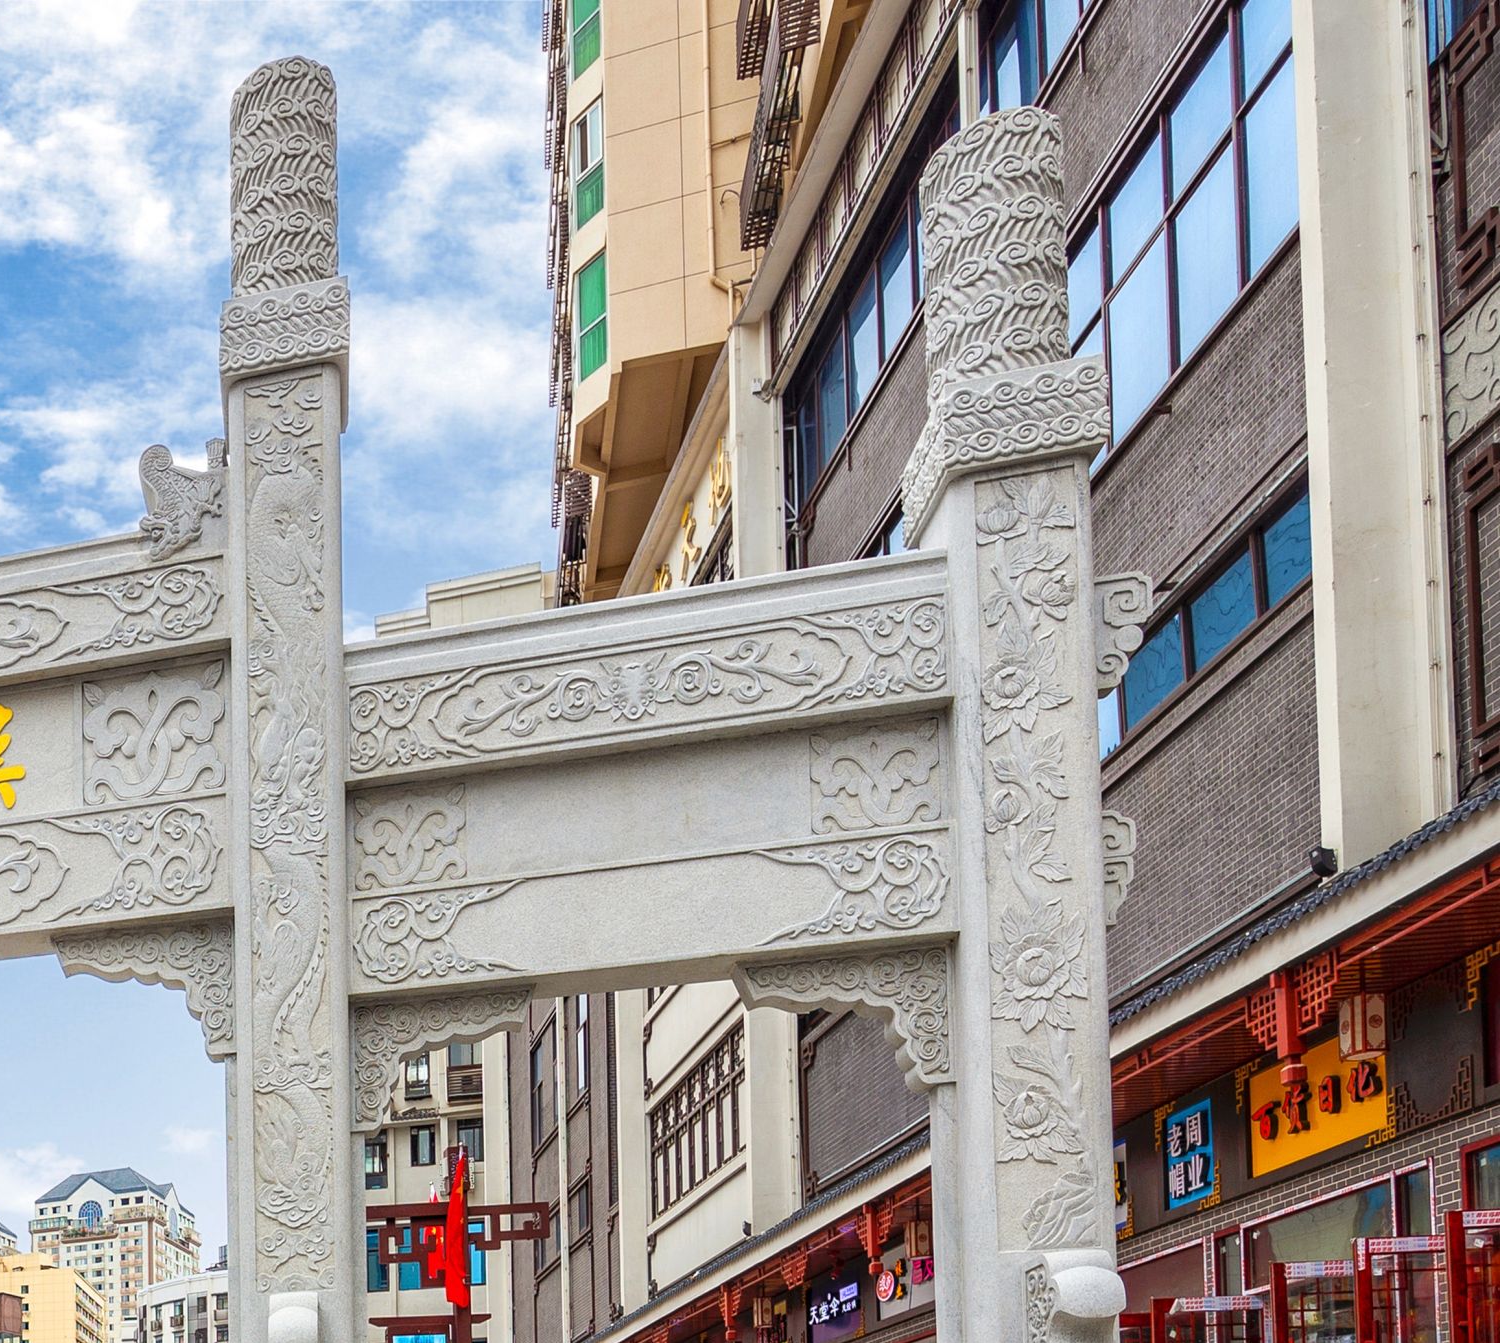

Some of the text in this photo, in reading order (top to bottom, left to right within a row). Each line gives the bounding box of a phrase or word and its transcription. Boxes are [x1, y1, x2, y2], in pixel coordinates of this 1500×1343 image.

[1251, 1061, 1381, 1141] 百货日化
[809, 1294, 841, 1325] 天堂伞
